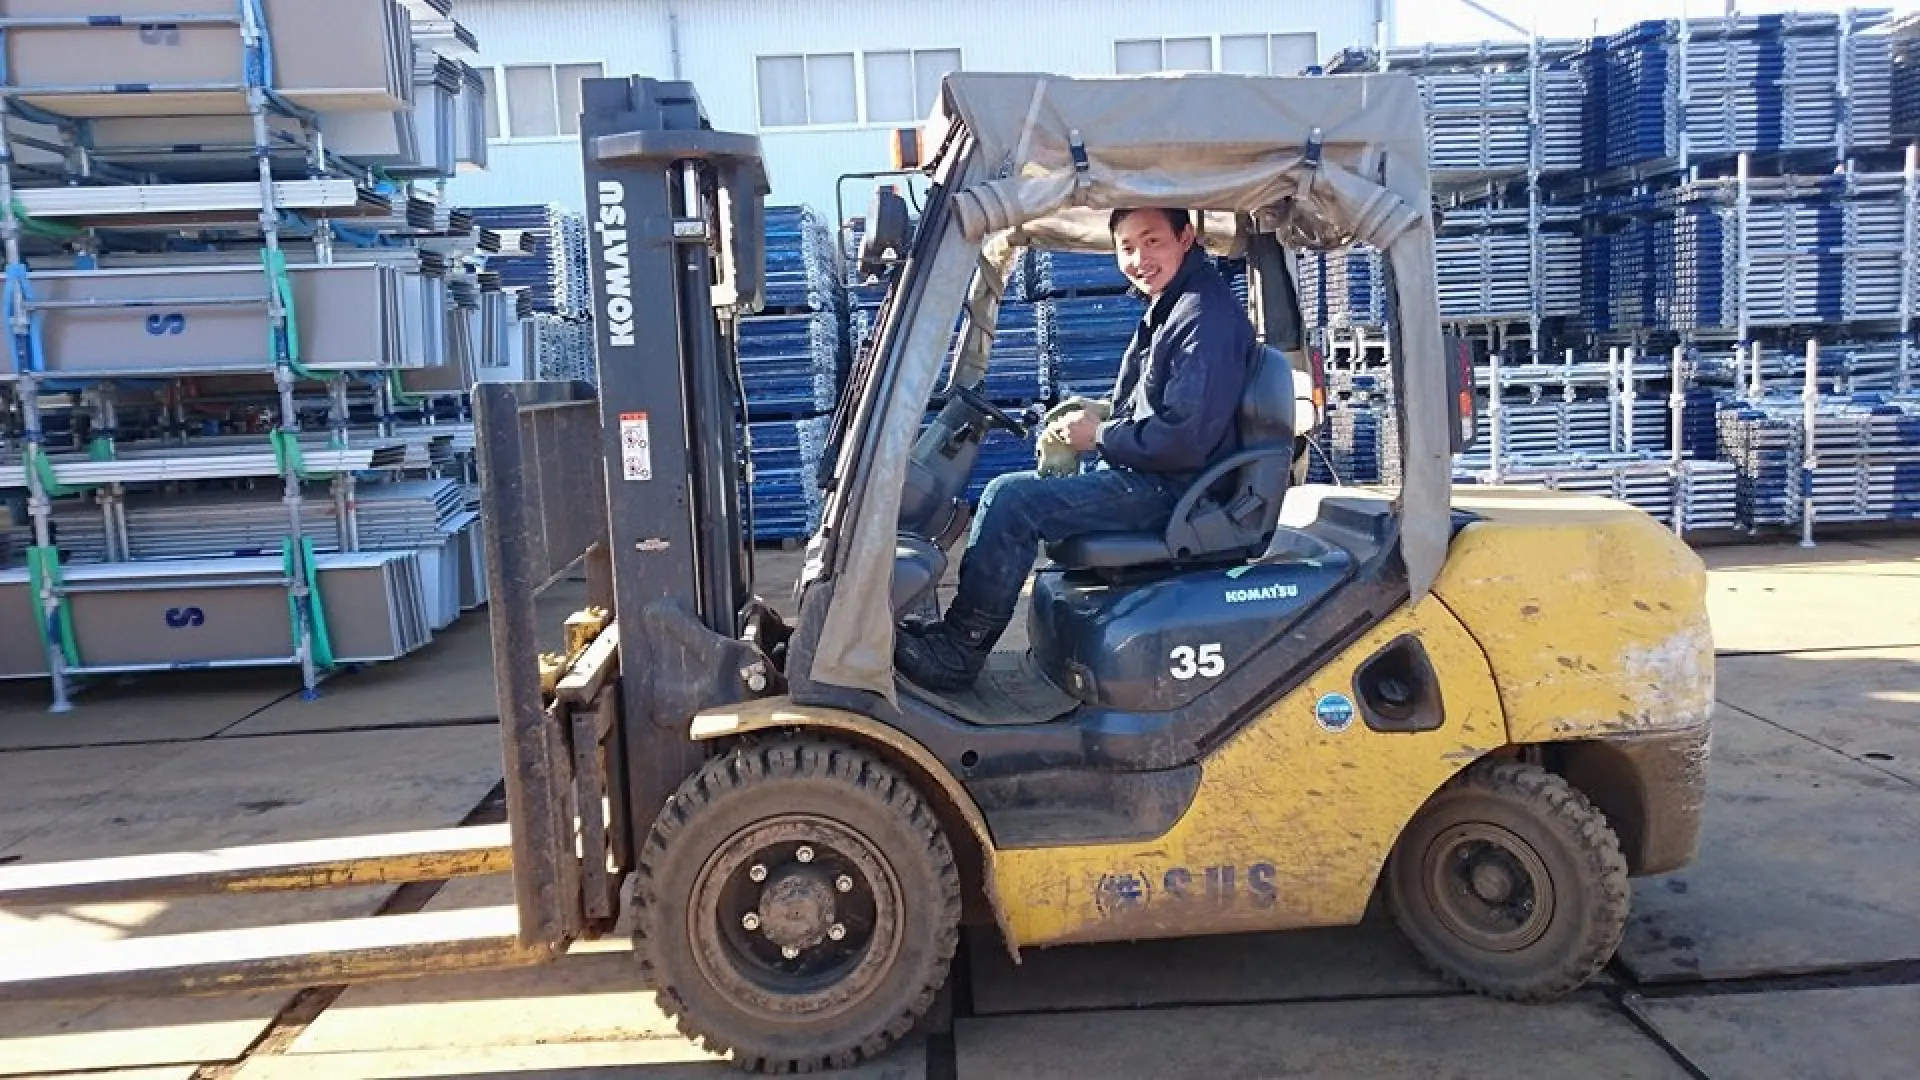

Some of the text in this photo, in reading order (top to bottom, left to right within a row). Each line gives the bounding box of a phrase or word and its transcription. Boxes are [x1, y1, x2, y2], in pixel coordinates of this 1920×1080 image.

[594, 180, 635, 347] KOMATSU
[1225, 583, 1299, 603] KOMATSU
[1169, 642, 1225, 680] 35
